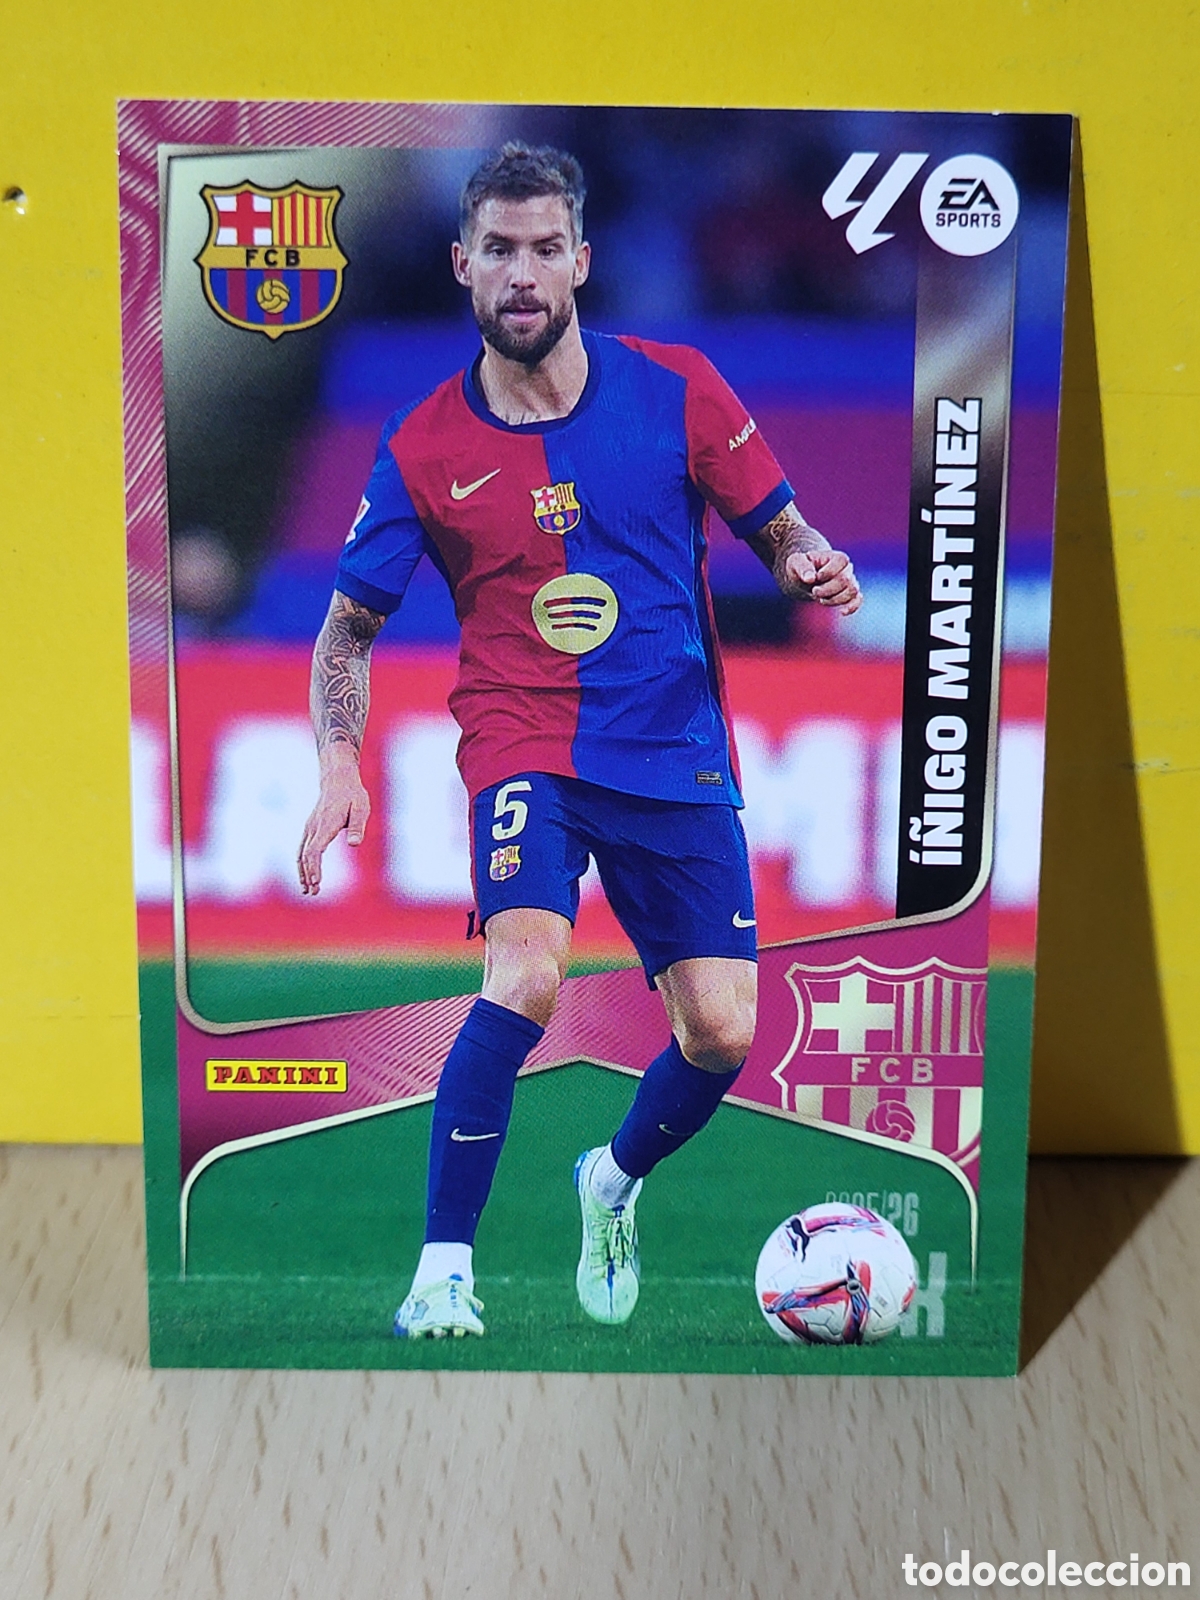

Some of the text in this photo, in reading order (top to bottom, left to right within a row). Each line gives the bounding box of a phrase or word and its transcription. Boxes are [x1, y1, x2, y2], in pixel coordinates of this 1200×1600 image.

[937, 178, 1000, 211] EA
[935, 212, 1002, 229] SPORTS
[910, 397, 982, 866] ÍÑIGO MARTÍNEZ
[491, 780, 533, 841] 5
[213, 1065, 339, 1085] PANINI
